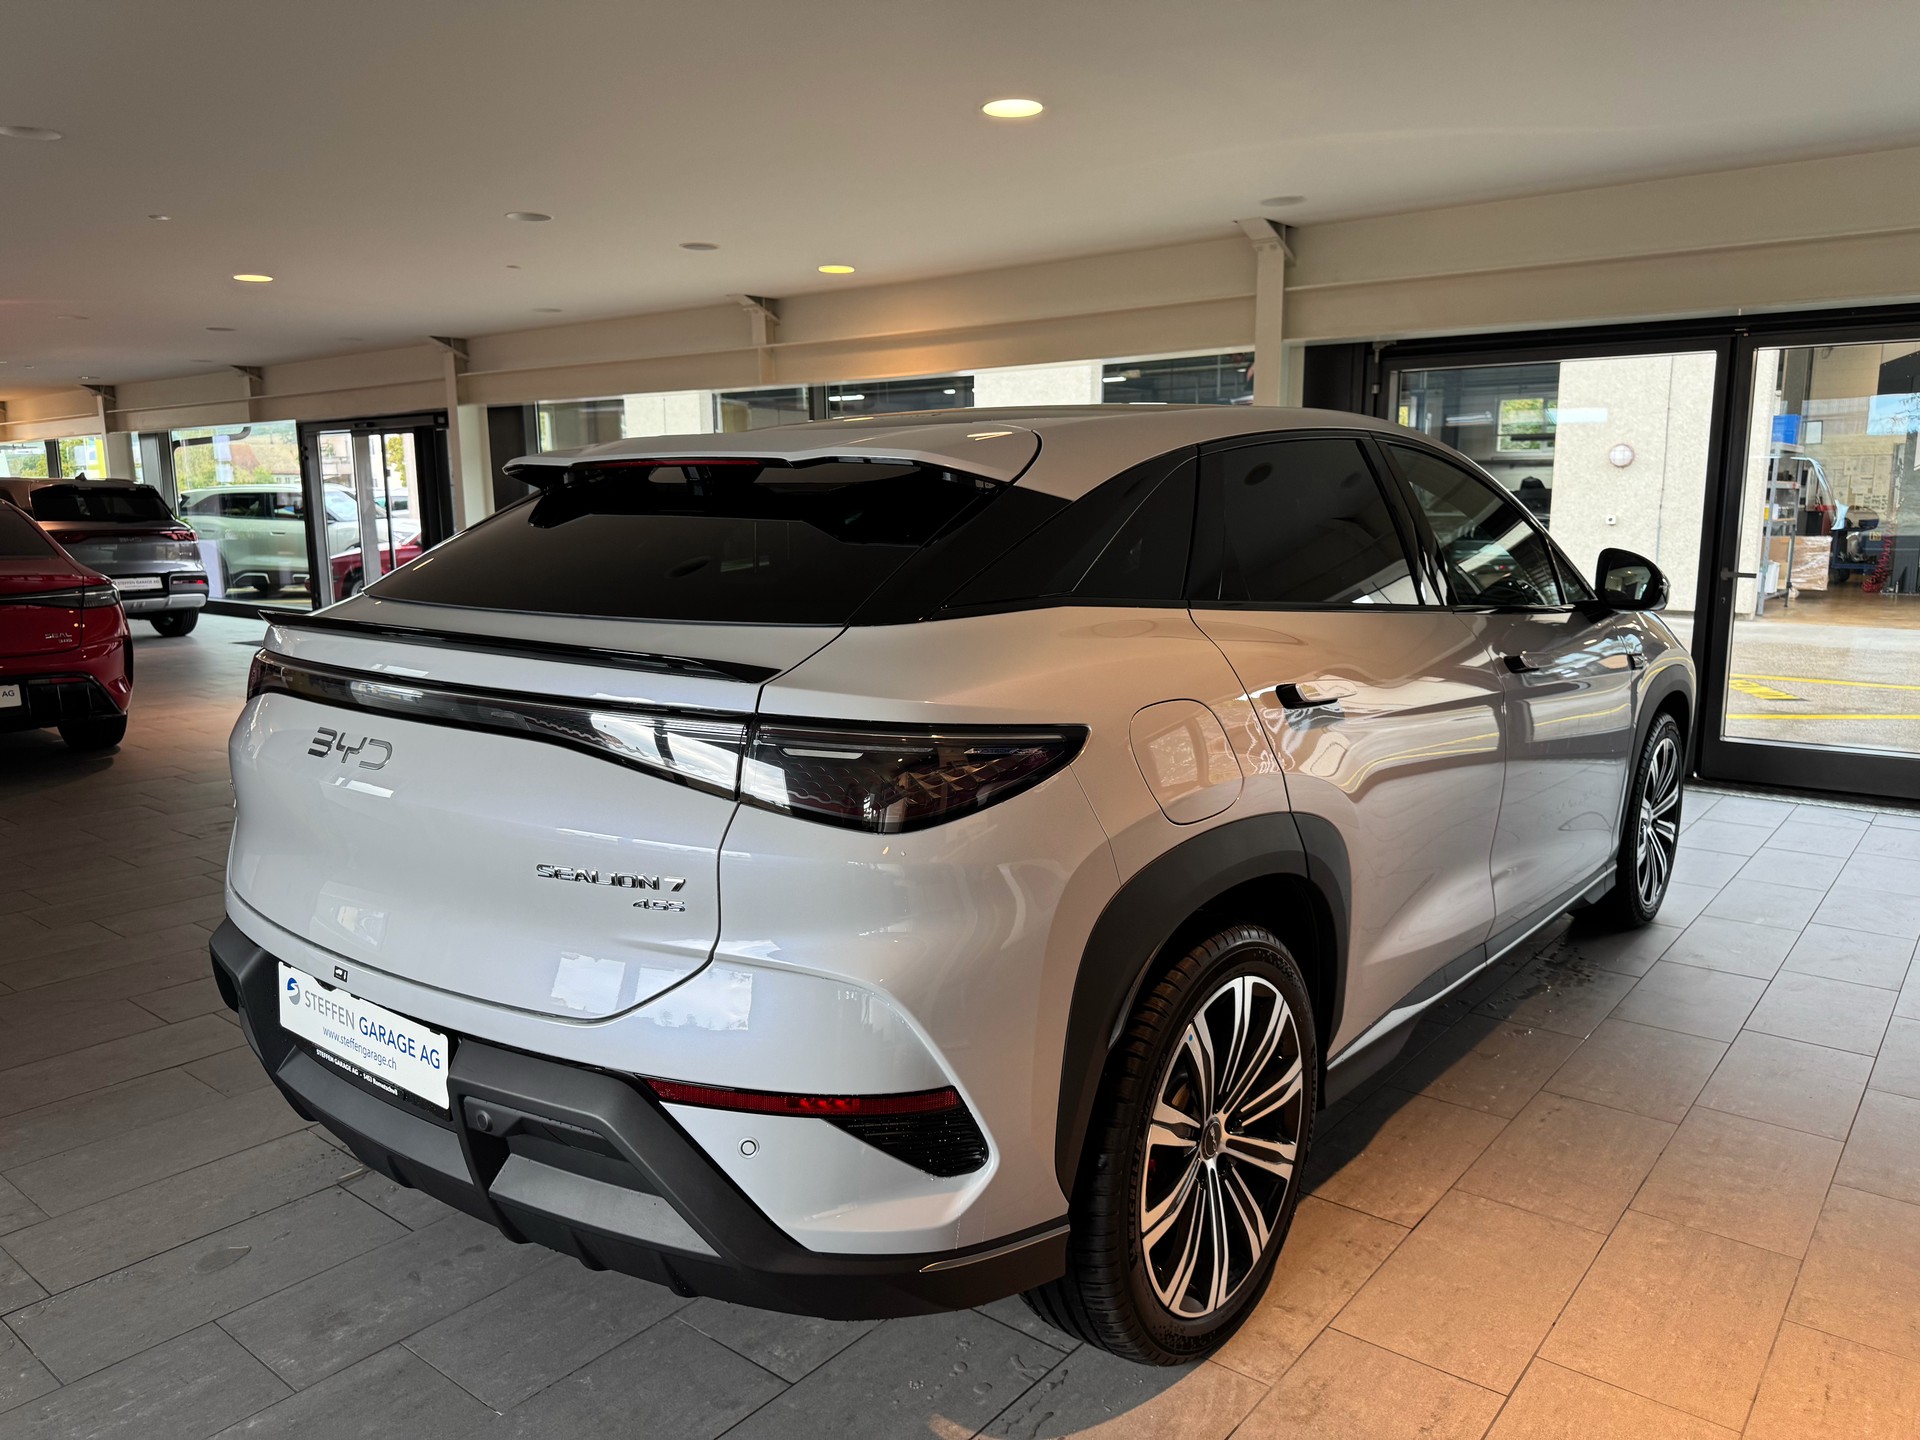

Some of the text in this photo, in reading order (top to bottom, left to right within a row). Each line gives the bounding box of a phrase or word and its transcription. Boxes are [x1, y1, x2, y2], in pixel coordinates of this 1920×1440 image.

[2, 690, 15, 698] AG
[308, 727, 393, 770] BYD
[535, 863, 686, 892] SEALION 7
[304, 989, 440, 1069] STEFFEN GARAGE AG
[322, 1026, 397, 1070] www.steffengarage.ch
